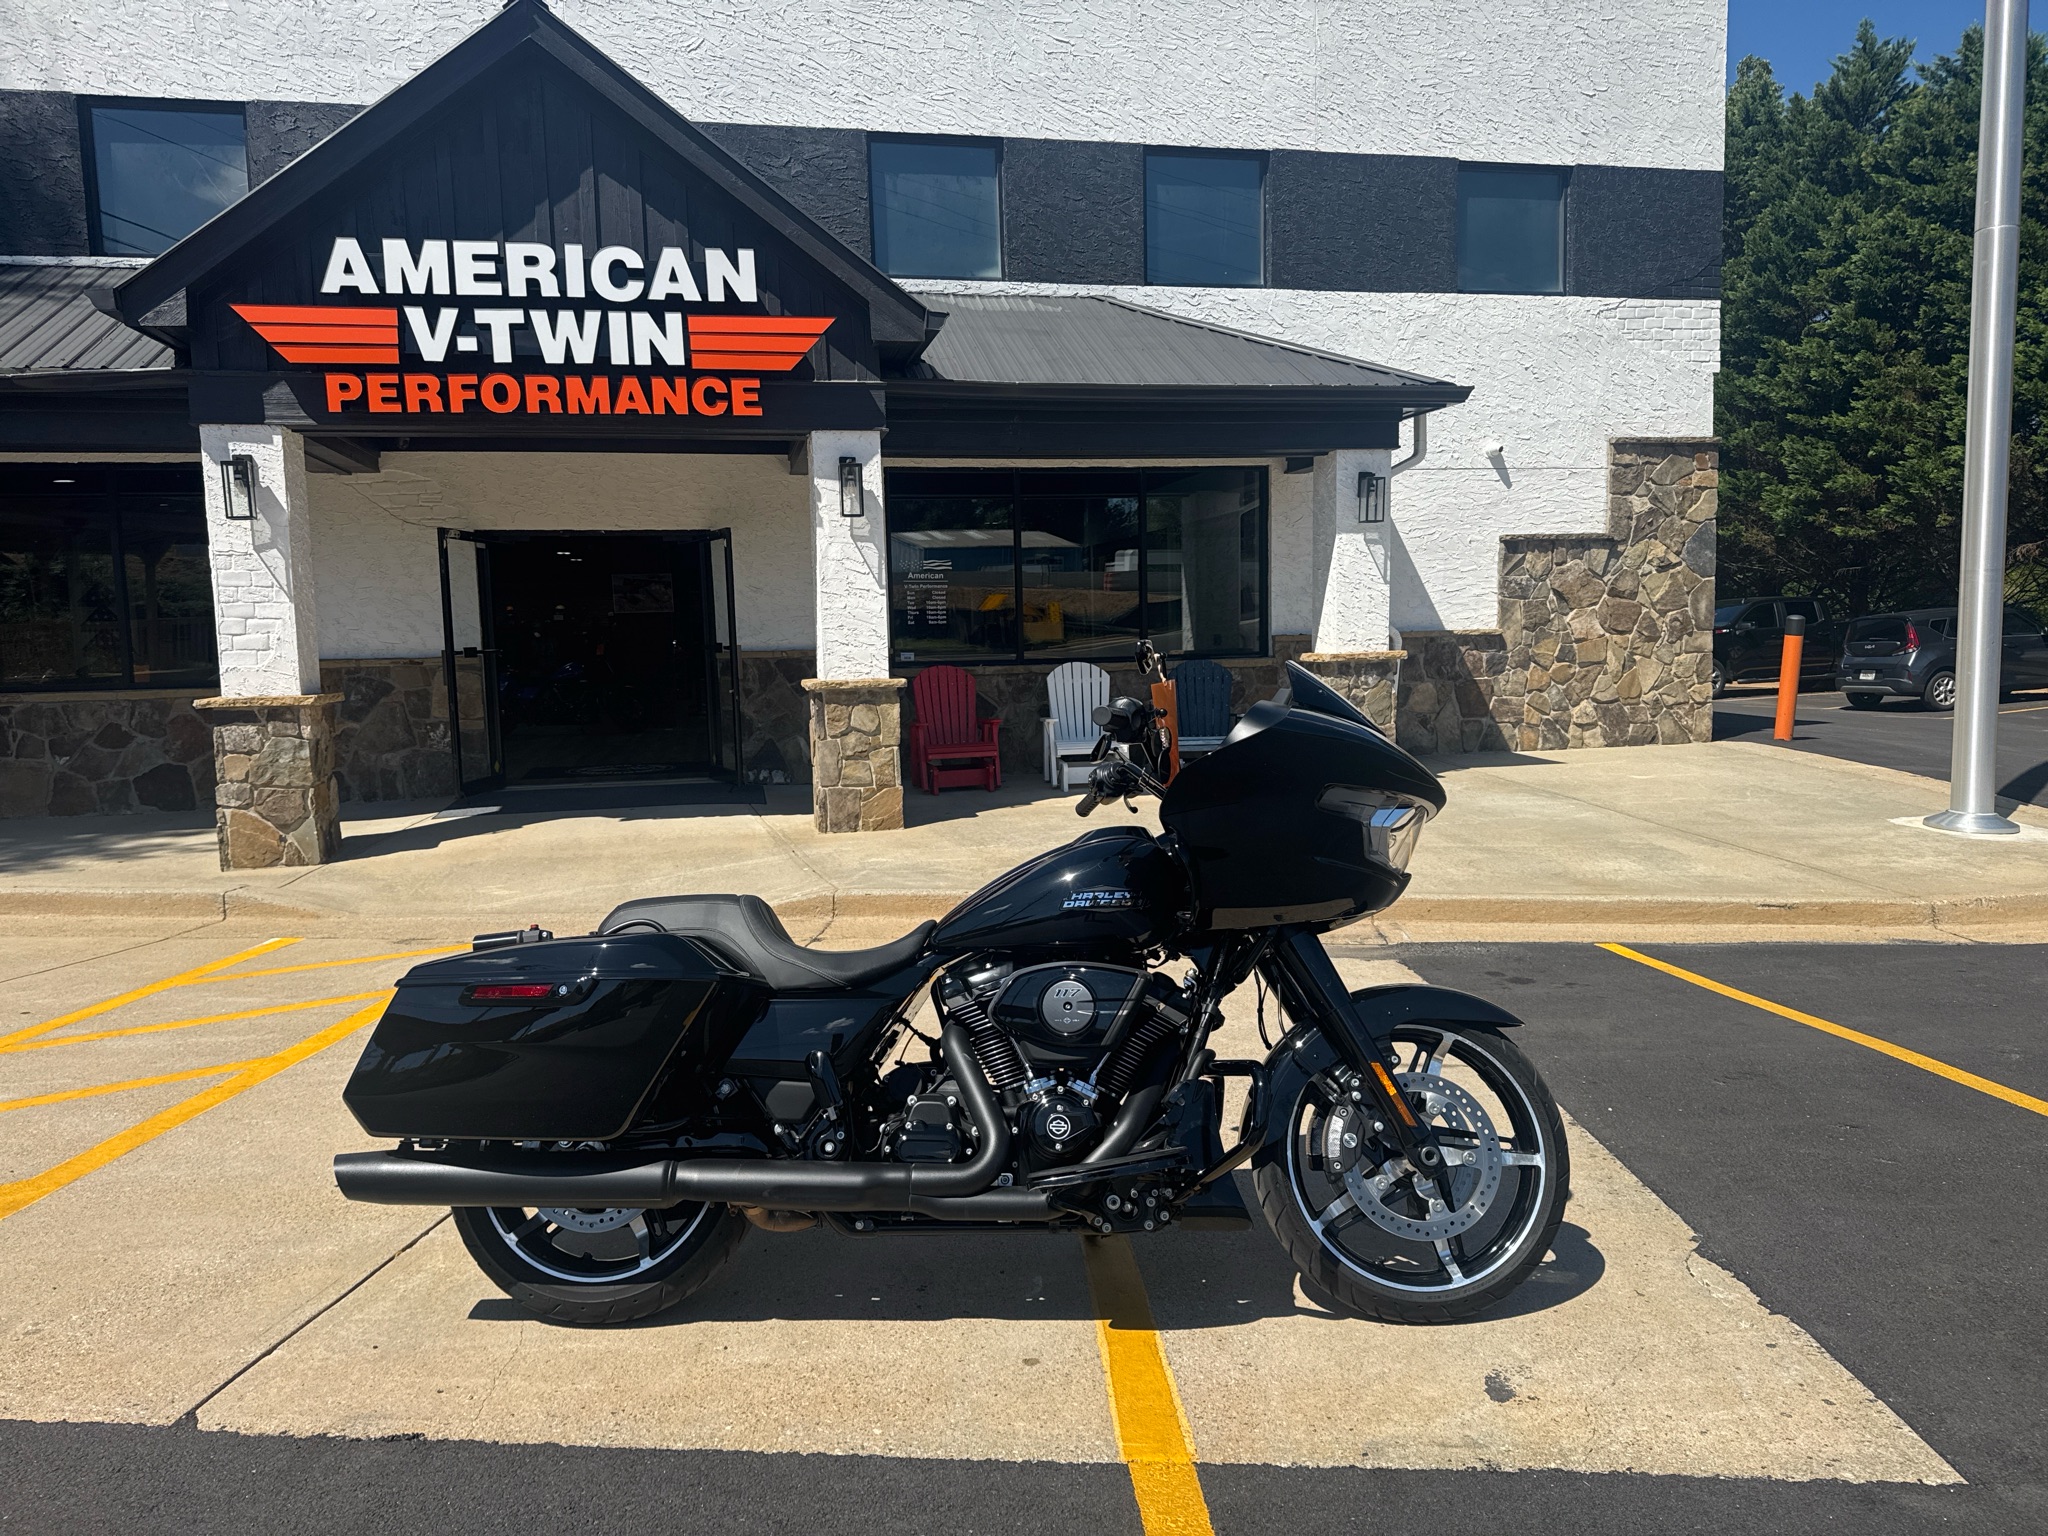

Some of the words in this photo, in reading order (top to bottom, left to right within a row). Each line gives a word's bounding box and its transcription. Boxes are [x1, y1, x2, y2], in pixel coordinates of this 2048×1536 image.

[319, 236, 758, 303] AMERICAN
[402, 305, 686, 366] V-TWIN
[324, 372, 763, 417] PERFORMANCE
[907, 572, 944, 580] American
[1071, 892, 1131, 900] HARLEY
[1054, 987, 1083, 999] 117
